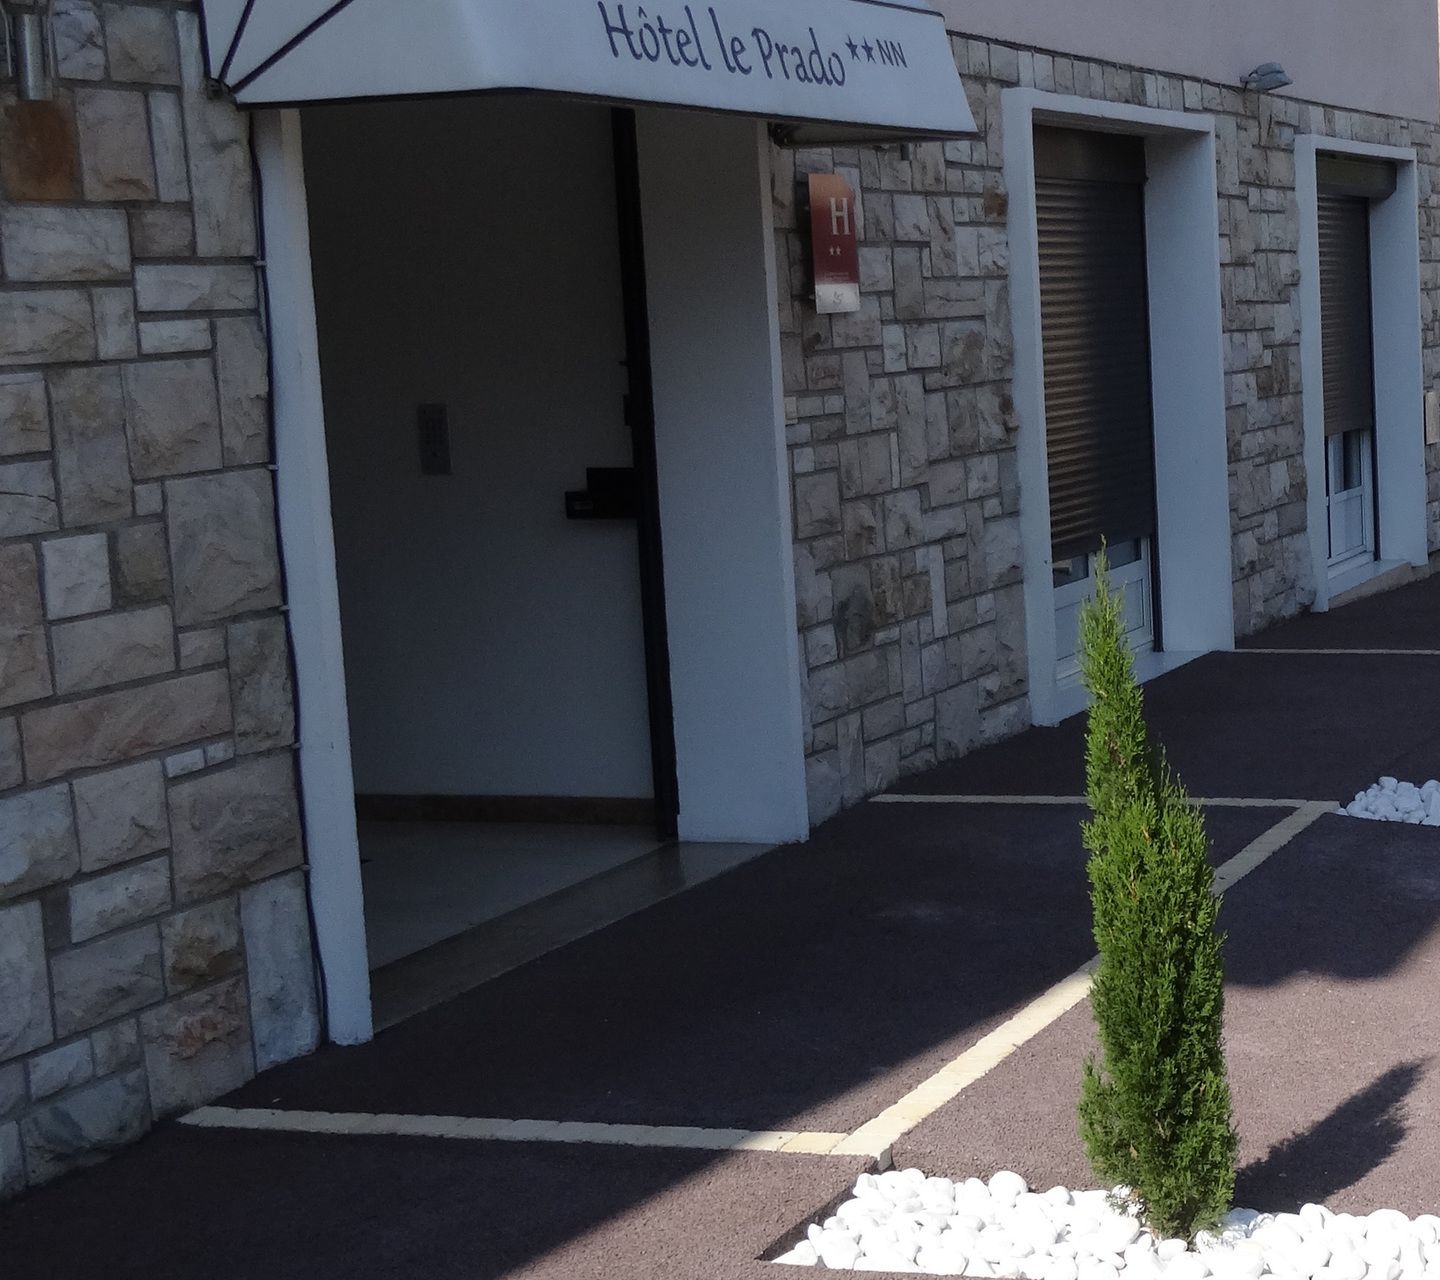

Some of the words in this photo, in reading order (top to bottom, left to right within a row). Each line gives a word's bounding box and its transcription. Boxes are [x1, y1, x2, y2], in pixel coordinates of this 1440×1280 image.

[597, 0, 712, 71] Hôtel
[708, 6, 752, 75] le
[751, 27, 846, 87] Prado
[829, 197, 851, 236] H
